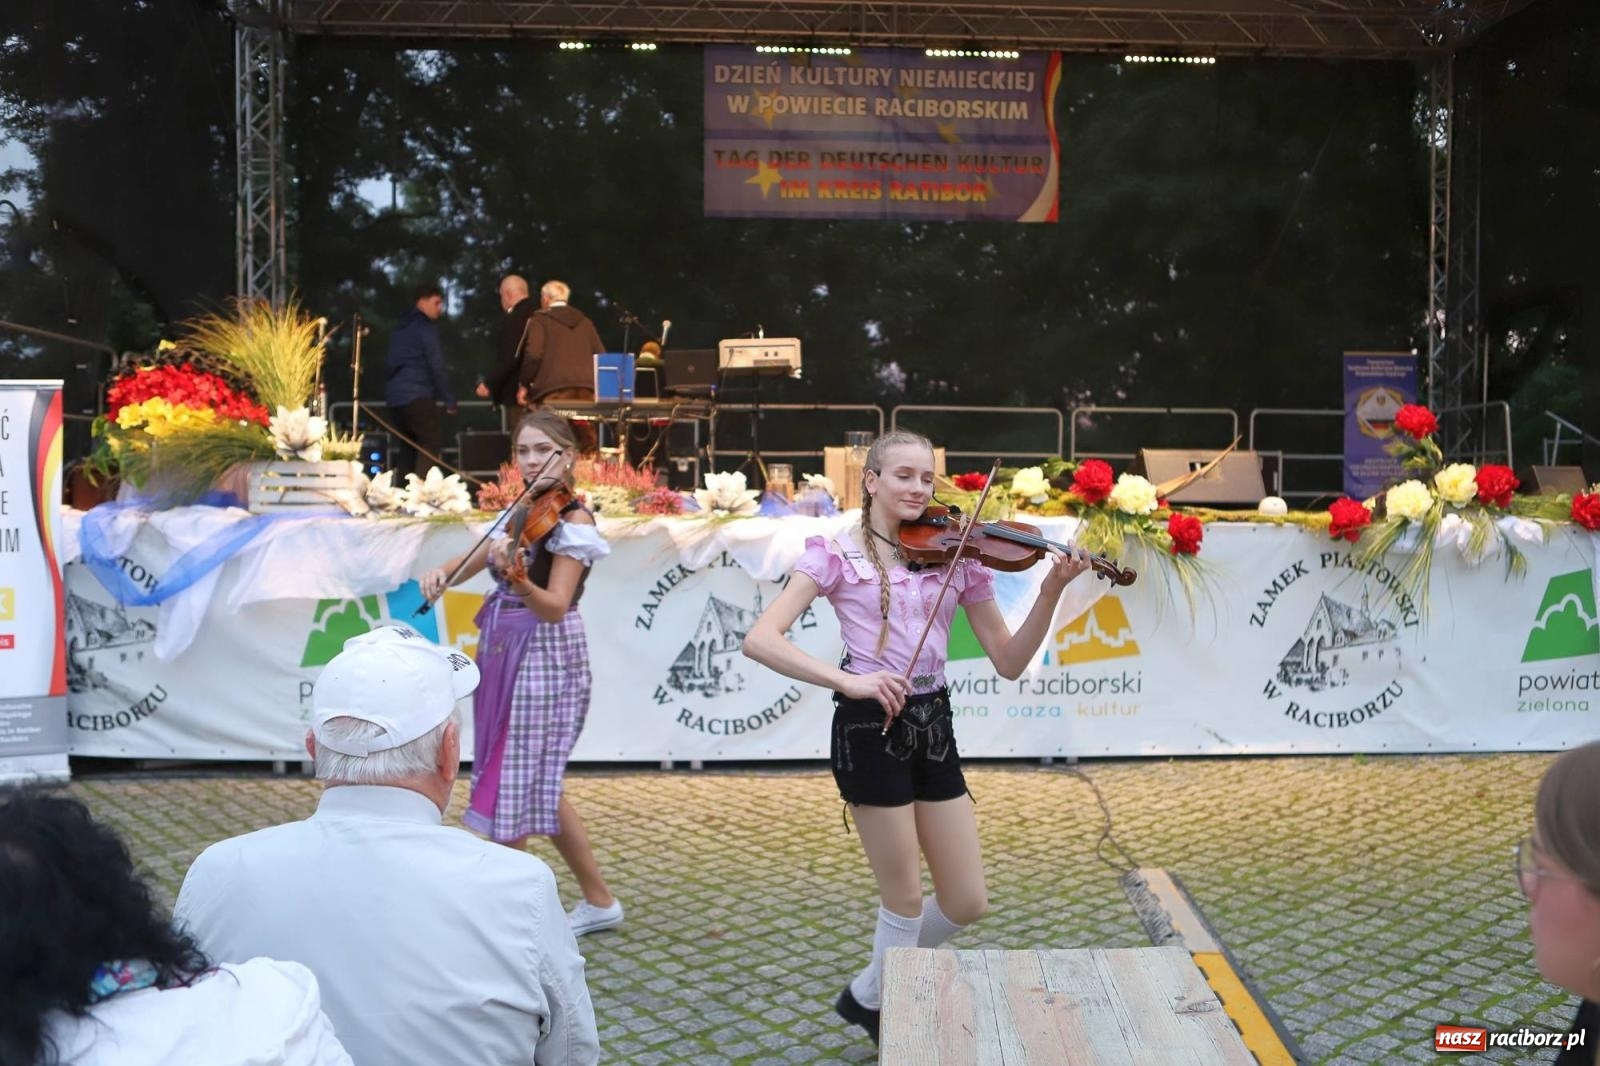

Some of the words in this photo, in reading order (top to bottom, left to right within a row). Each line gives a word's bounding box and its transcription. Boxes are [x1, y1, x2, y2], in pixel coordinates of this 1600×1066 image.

[714, 61, 781, 84] DZIEŃ
[790, 65, 893, 88] KULTURY
[901, 68, 1035, 92] NIEMIECKIEJ
[727, 95, 748, 114] W
[759, 95, 867, 116] POWIECIE
[876, 98, 1029, 120] RACIBORSKIM
[714, 150, 760, 169] TAG
[769, 150, 813, 170] DER
[821, 150, 949, 173] DEUTSCHEN
[958, 154, 1044, 176] KULTUR
[780, 179, 809, 199] IM
[818, 179, 882, 201] KREIS
[889, 180, 987, 203] RATIBOR
[635, 563, 696, 631] ZAMEK
[1249, 560, 1310, 628] ZAMEK
[1518, 668, 1600, 698] powiat
[652, 684, 673, 706] W
[676, 685, 803, 735] RACIBORZU
[1006, 704, 1062, 719] oaza
[1077, 702, 1141, 718] kultur
[1263, 679, 1283, 700] W
[1285, 680, 1404, 729] RACIBORZU
[1517, 697, 1590, 713] zielona
